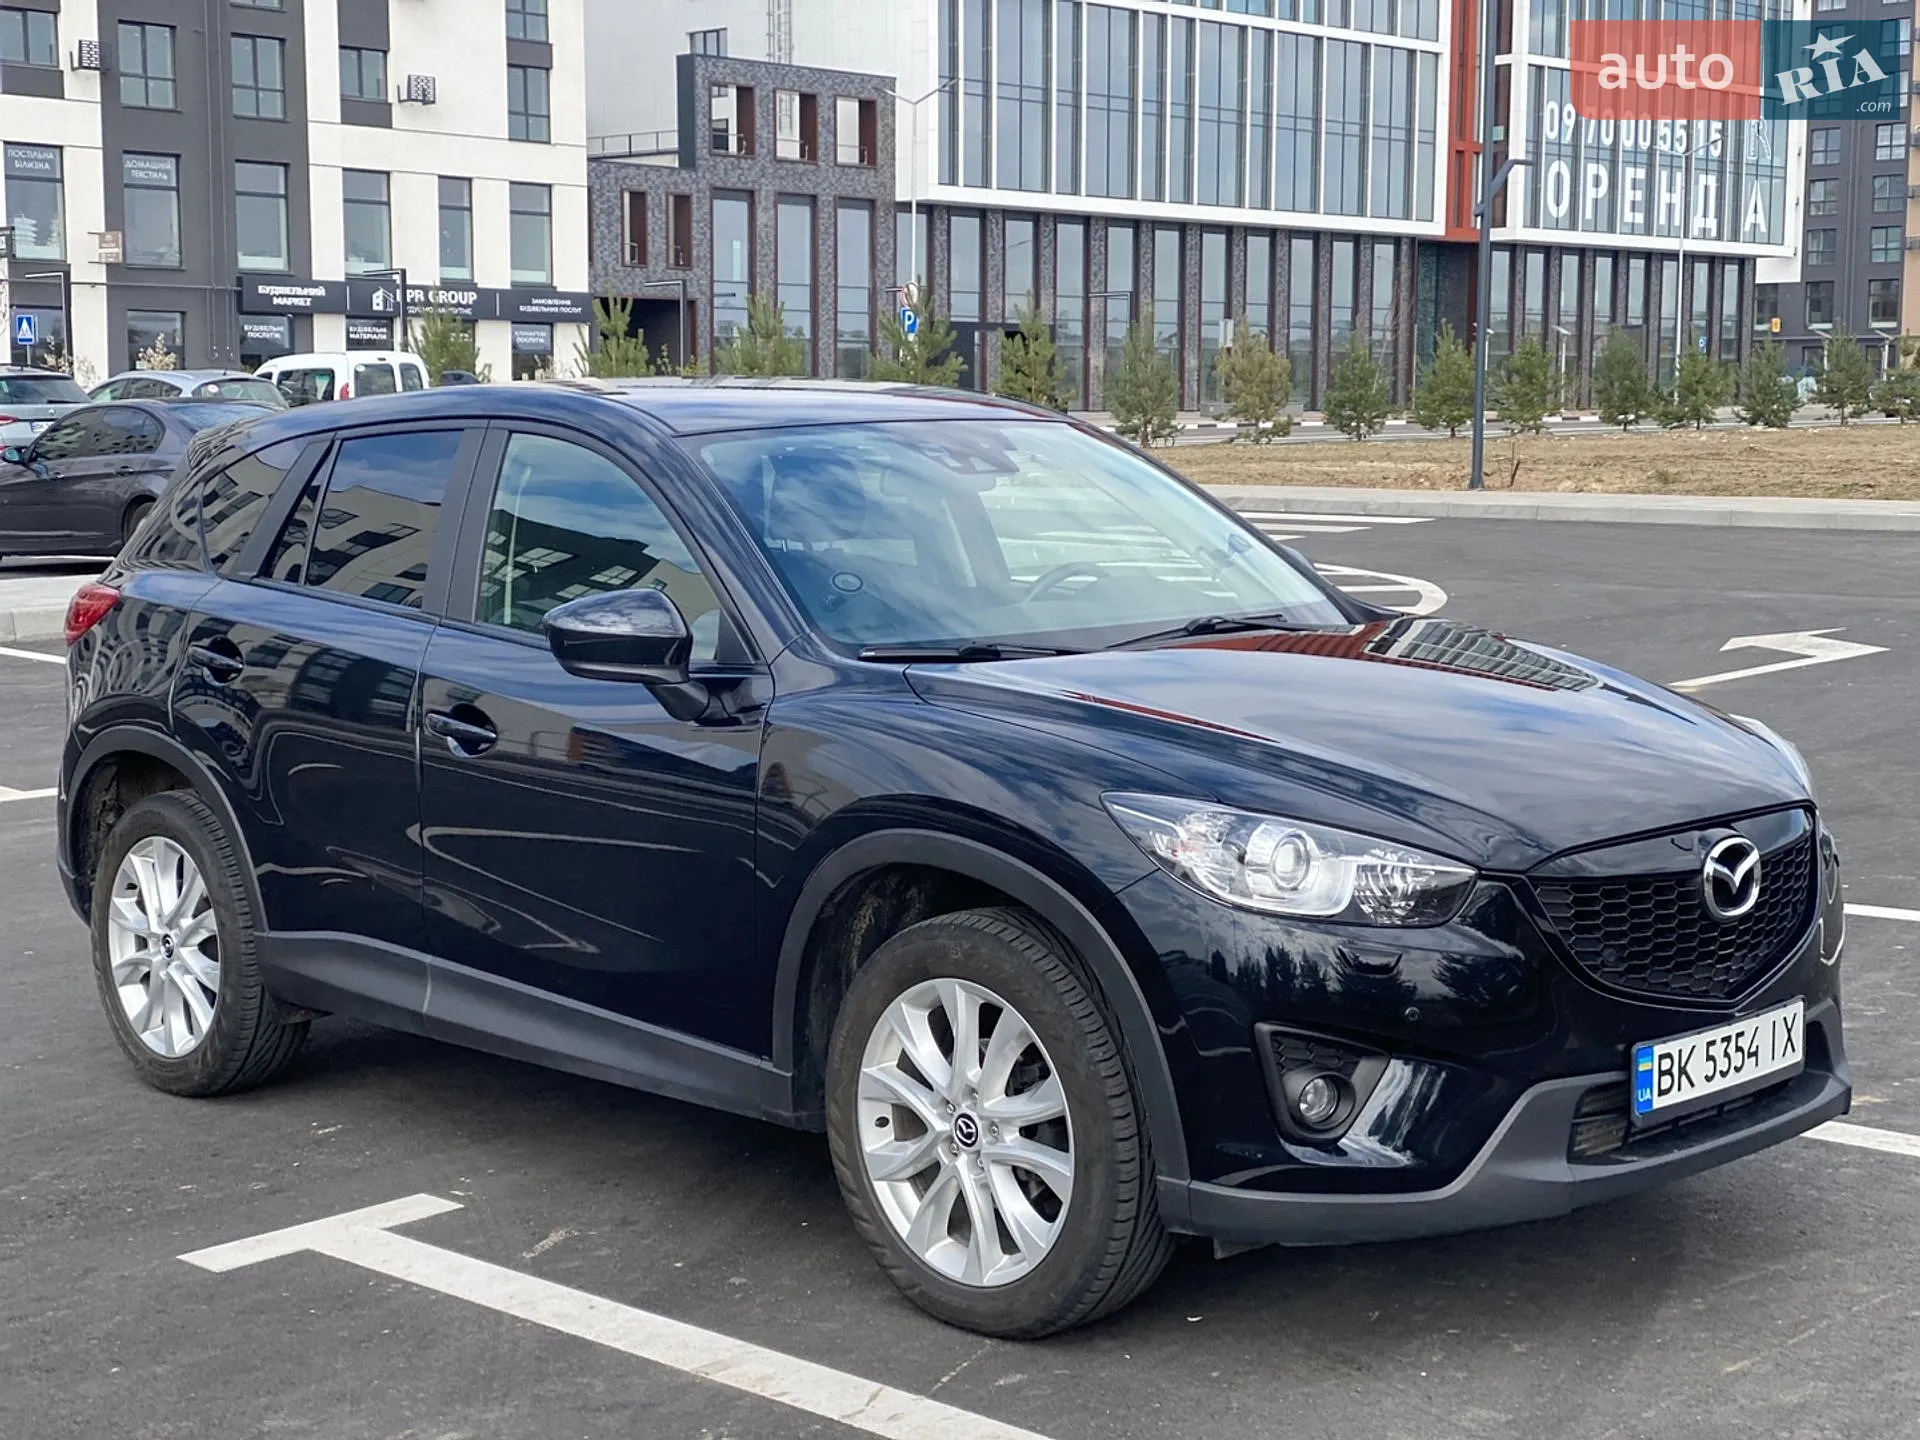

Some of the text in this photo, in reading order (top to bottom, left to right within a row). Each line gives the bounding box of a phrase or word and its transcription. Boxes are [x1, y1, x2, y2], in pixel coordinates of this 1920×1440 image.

[14, 159, 51, 170] БІЛИЗНА
[130, 169, 168, 180] ТЕКСТИЛЬ
[1547, 160, 1767, 238] ОРЕНДА
[272, 296, 312, 306] МАРКЕТ
[1657, 1012, 1797, 1097] BK 5354 IX
[1638, 1087, 1651, 1102] UA
